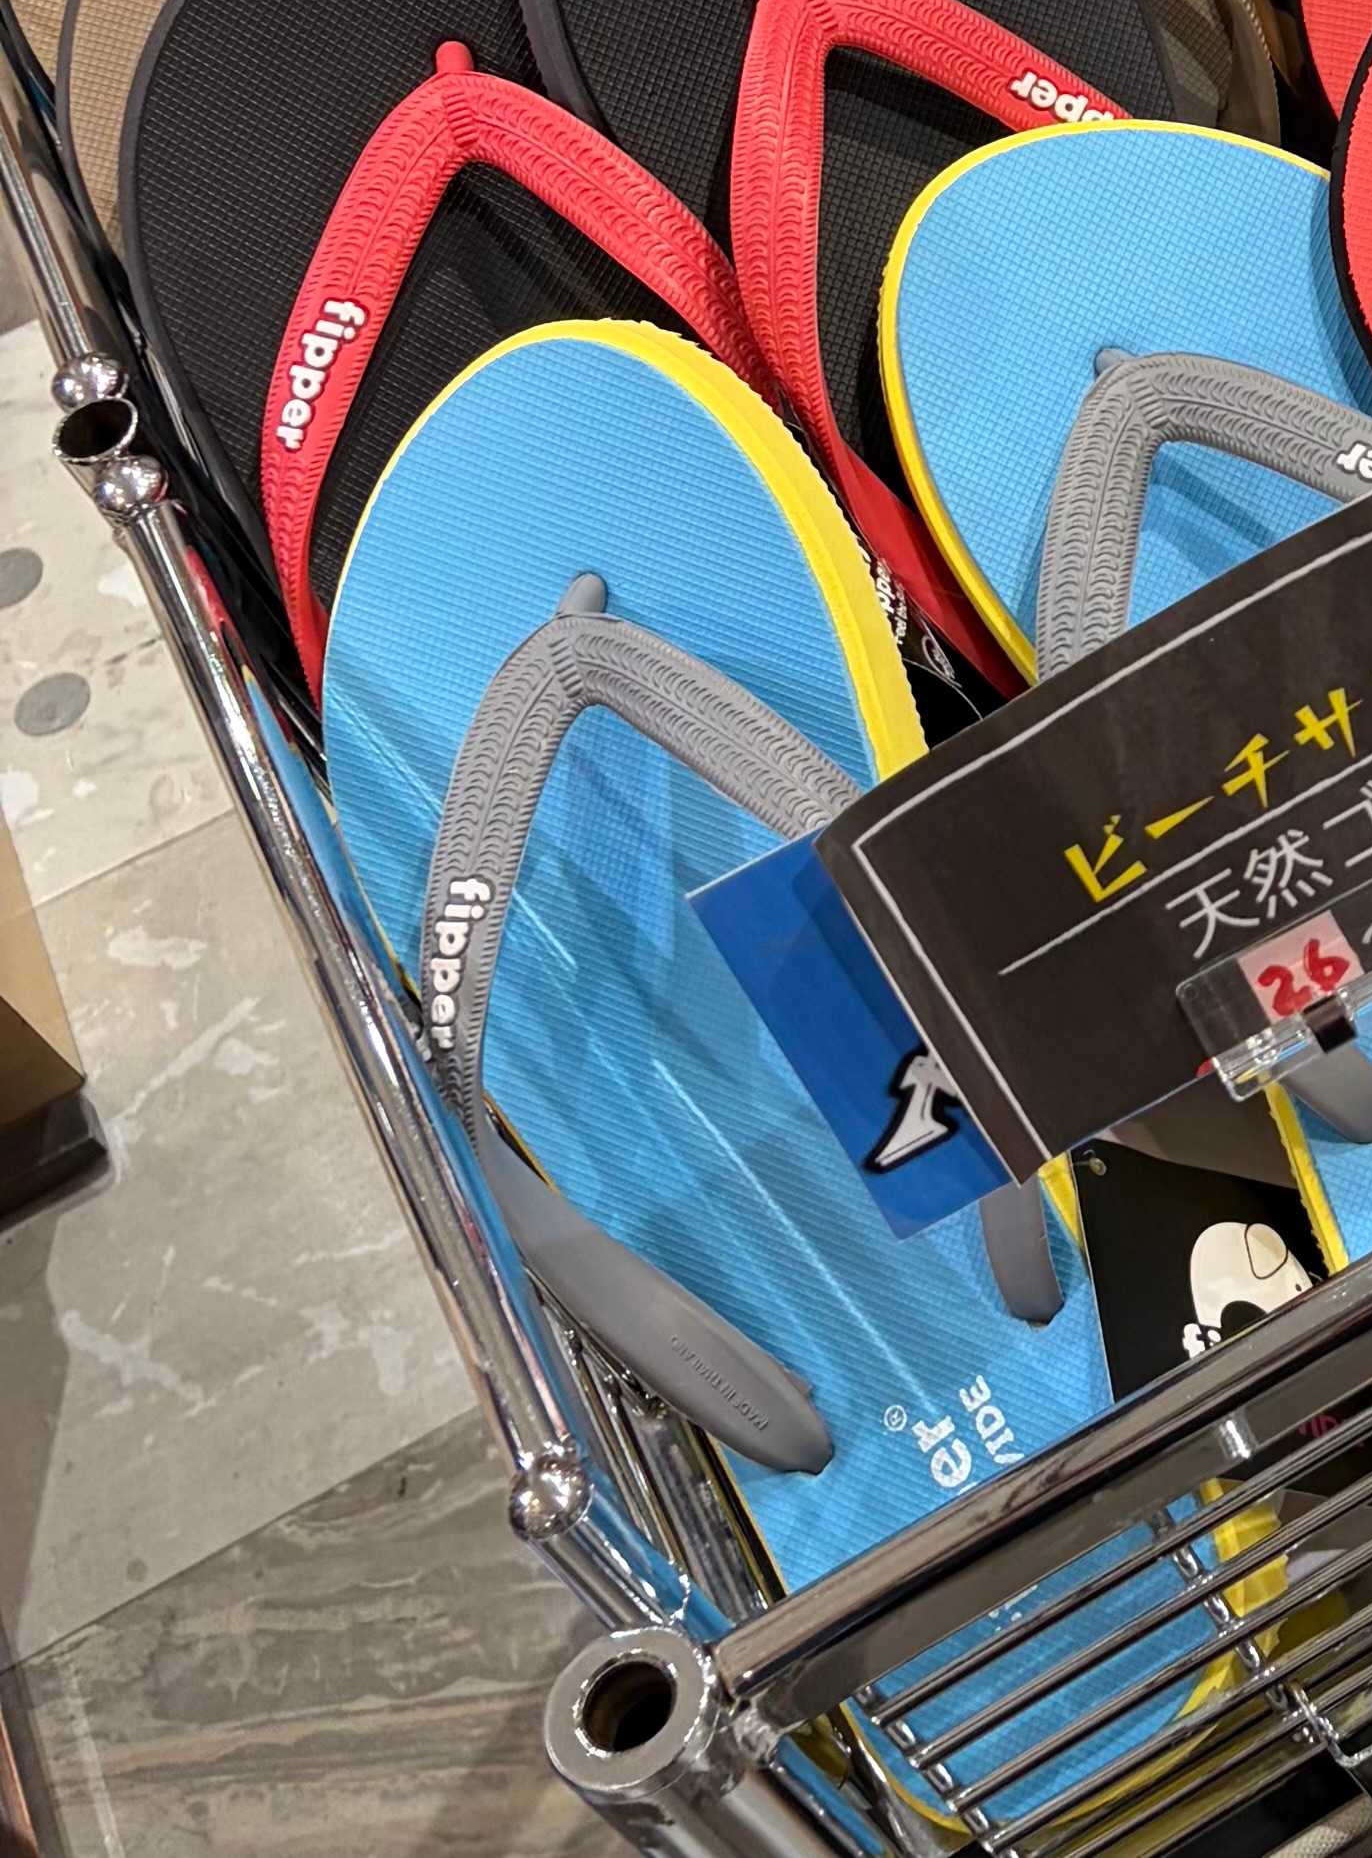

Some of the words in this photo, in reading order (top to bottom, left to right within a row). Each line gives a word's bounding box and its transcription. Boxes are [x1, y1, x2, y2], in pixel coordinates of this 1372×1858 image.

[276, 299, 366, 450] fipper
[429, 879, 491, 1049] fipper
[1258, 938, 1352, 1018] 26
